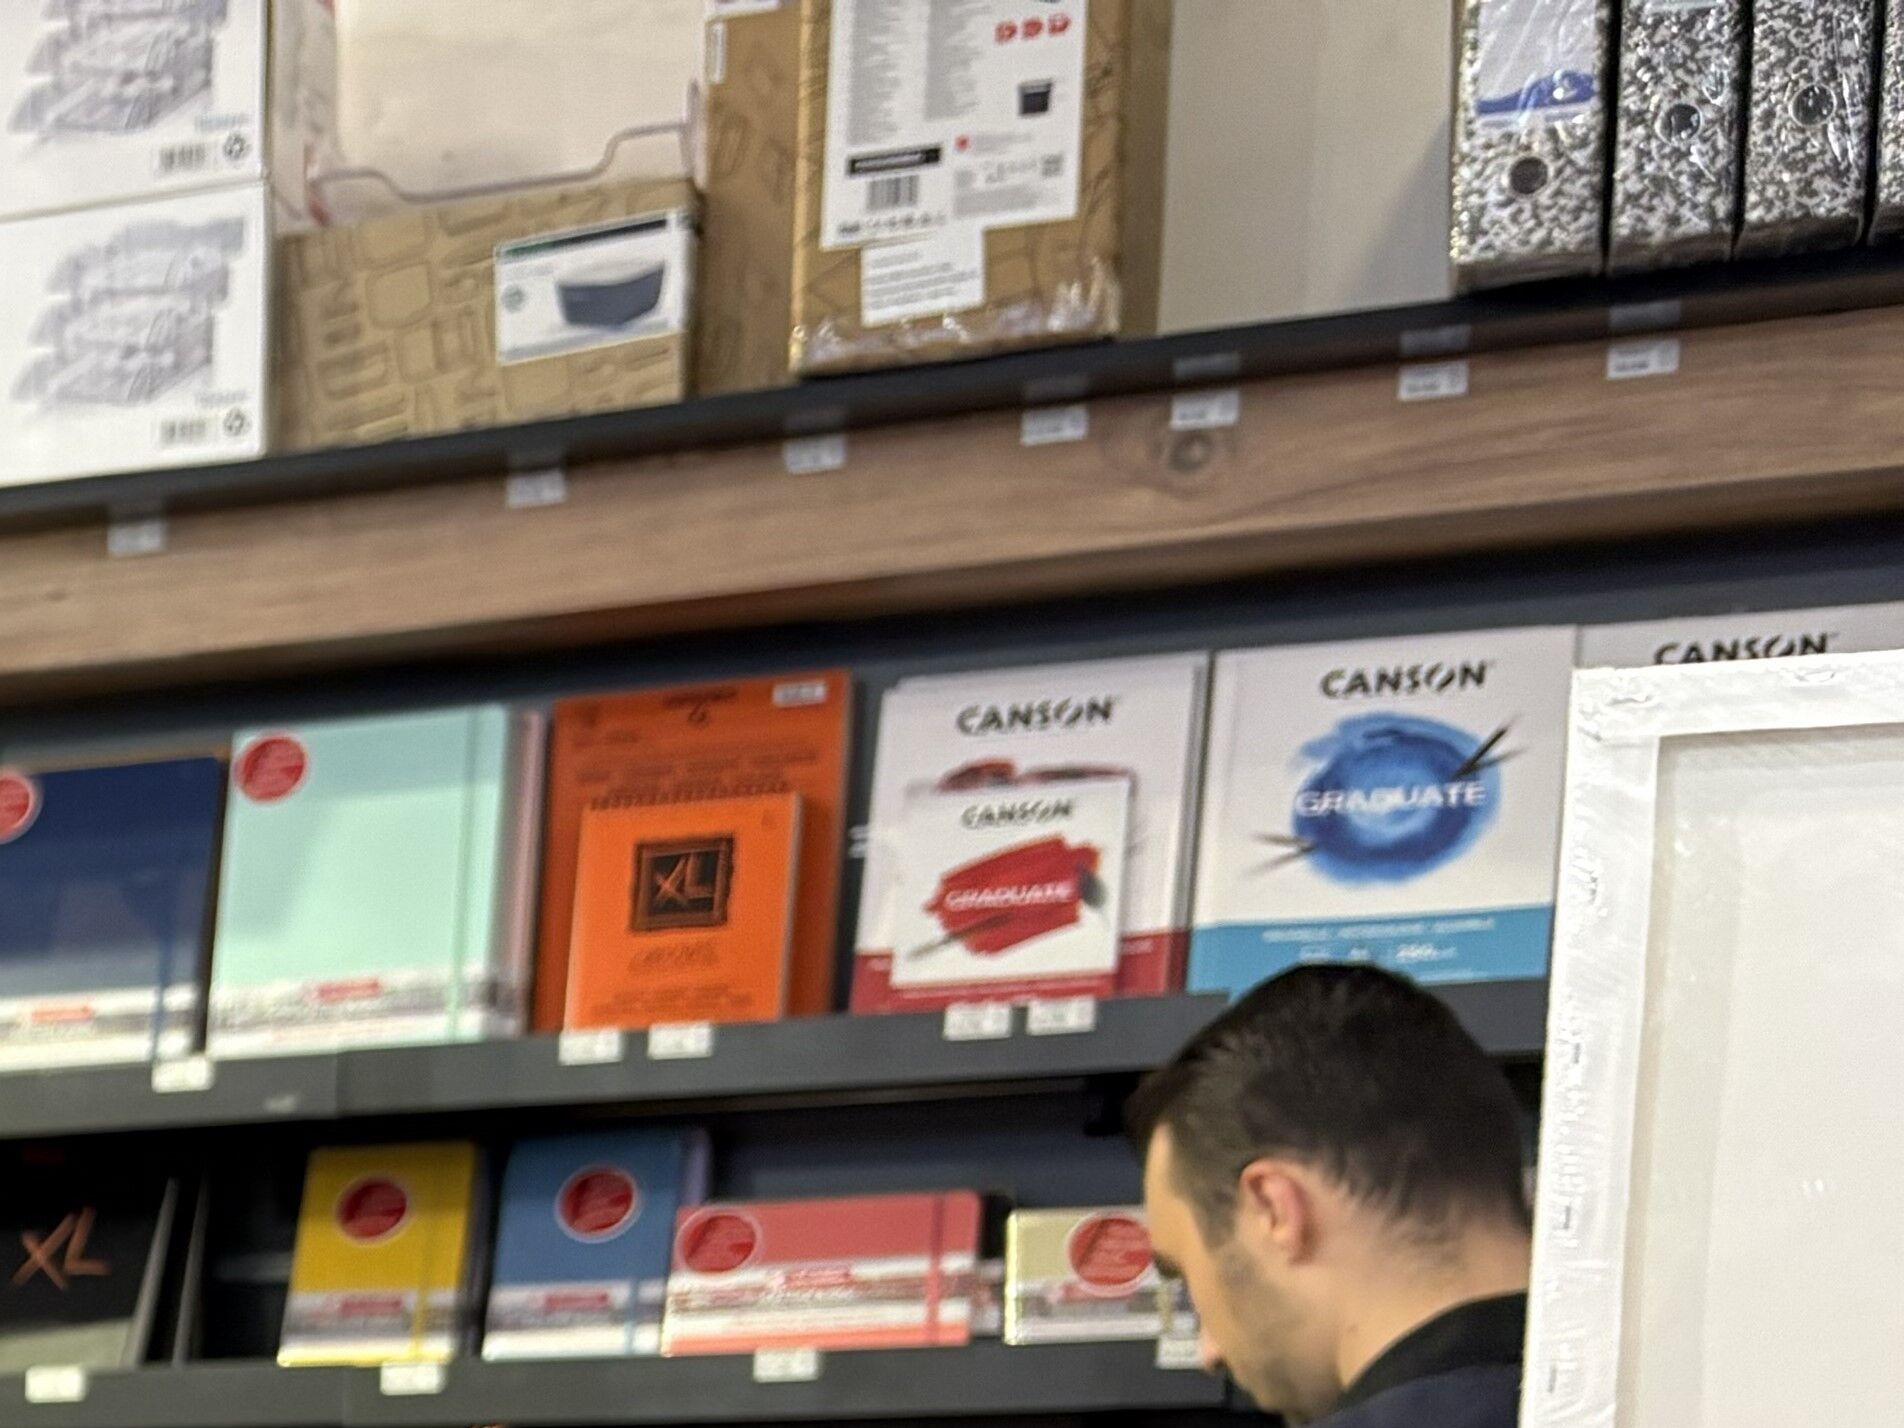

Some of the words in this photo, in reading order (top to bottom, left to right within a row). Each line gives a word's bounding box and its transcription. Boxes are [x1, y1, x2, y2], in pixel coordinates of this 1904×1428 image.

[1654, 633, 1829, 665] CANSON
[1319, 660, 1489, 699] CANSON
[956, 697, 1116, 736] CANSON
[960, 797, 1075, 829] CANSON
[1295, 779, 1487, 818] GRADUATE
[655, 857, 717, 903] XL
[944, 880, 1075, 909] GRADUATE
[13, 1207, 110, 1291] XL
